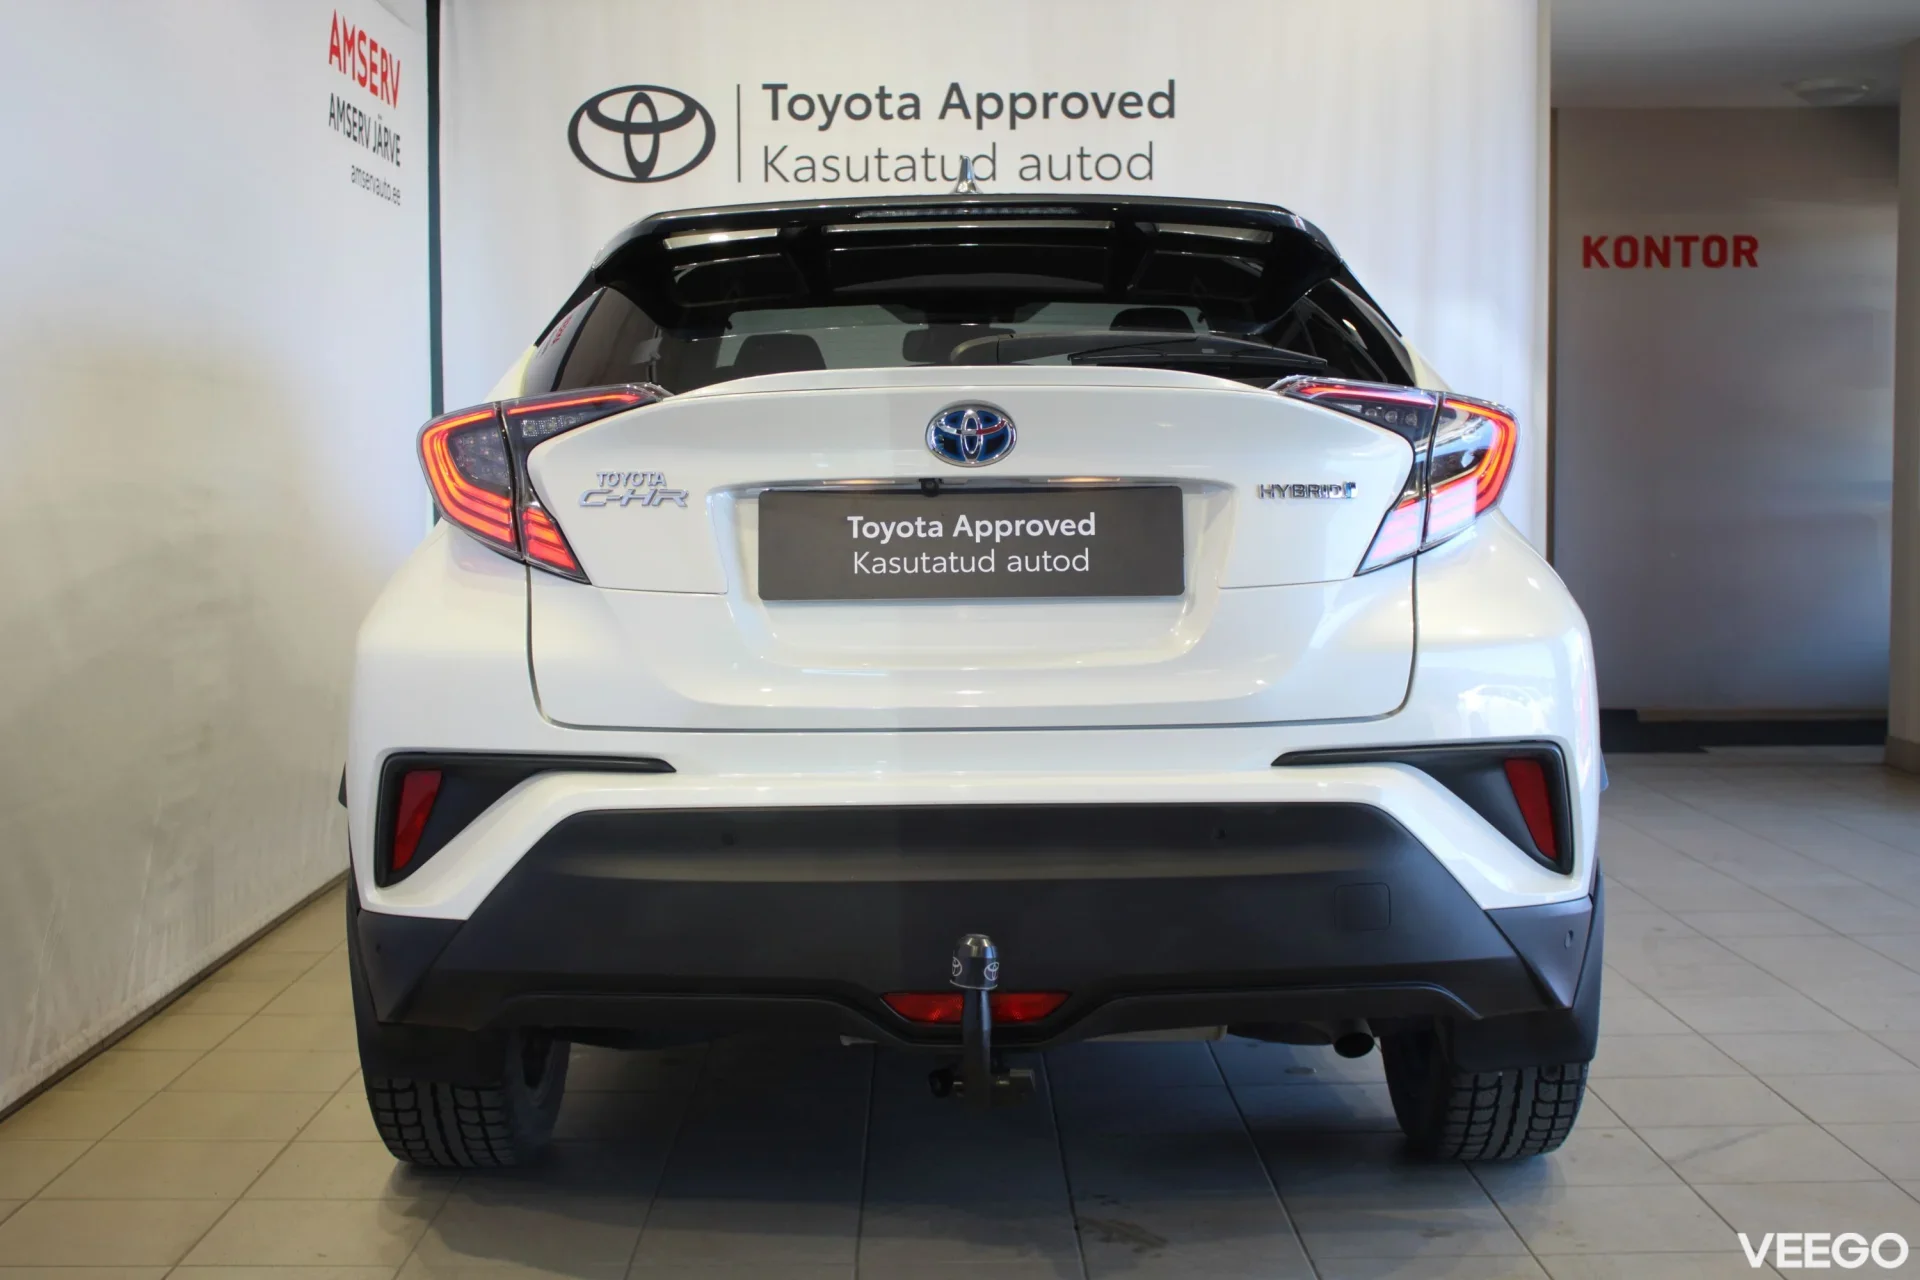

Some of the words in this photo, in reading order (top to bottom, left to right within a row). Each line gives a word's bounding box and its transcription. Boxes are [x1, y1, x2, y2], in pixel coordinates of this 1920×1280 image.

[328, 8, 401, 110] AMSERV
[762, 83, 920, 131] Toyota
[938, 79, 1176, 130] Approved
[328, 92, 372, 149] AMSERV
[372, 113, 401, 167] JÄRVE
[762, 141, 997, 183] Kasutatud
[1017, 141, 1155, 182] autod
[350, 164, 401, 206] amservauto.ee
[1582, 234, 1759, 269] KONTOR
[596, 471, 668, 487] TOYOTA
[1257, 483, 1343, 499] HYBRID
[578, 488, 690, 508] C-HR
[847, 515, 944, 545] Toyota
[952, 511, 1097, 543] Approved
[853, 548, 996, 575] Kasutatud
[1006, 547, 1091, 573] autod
